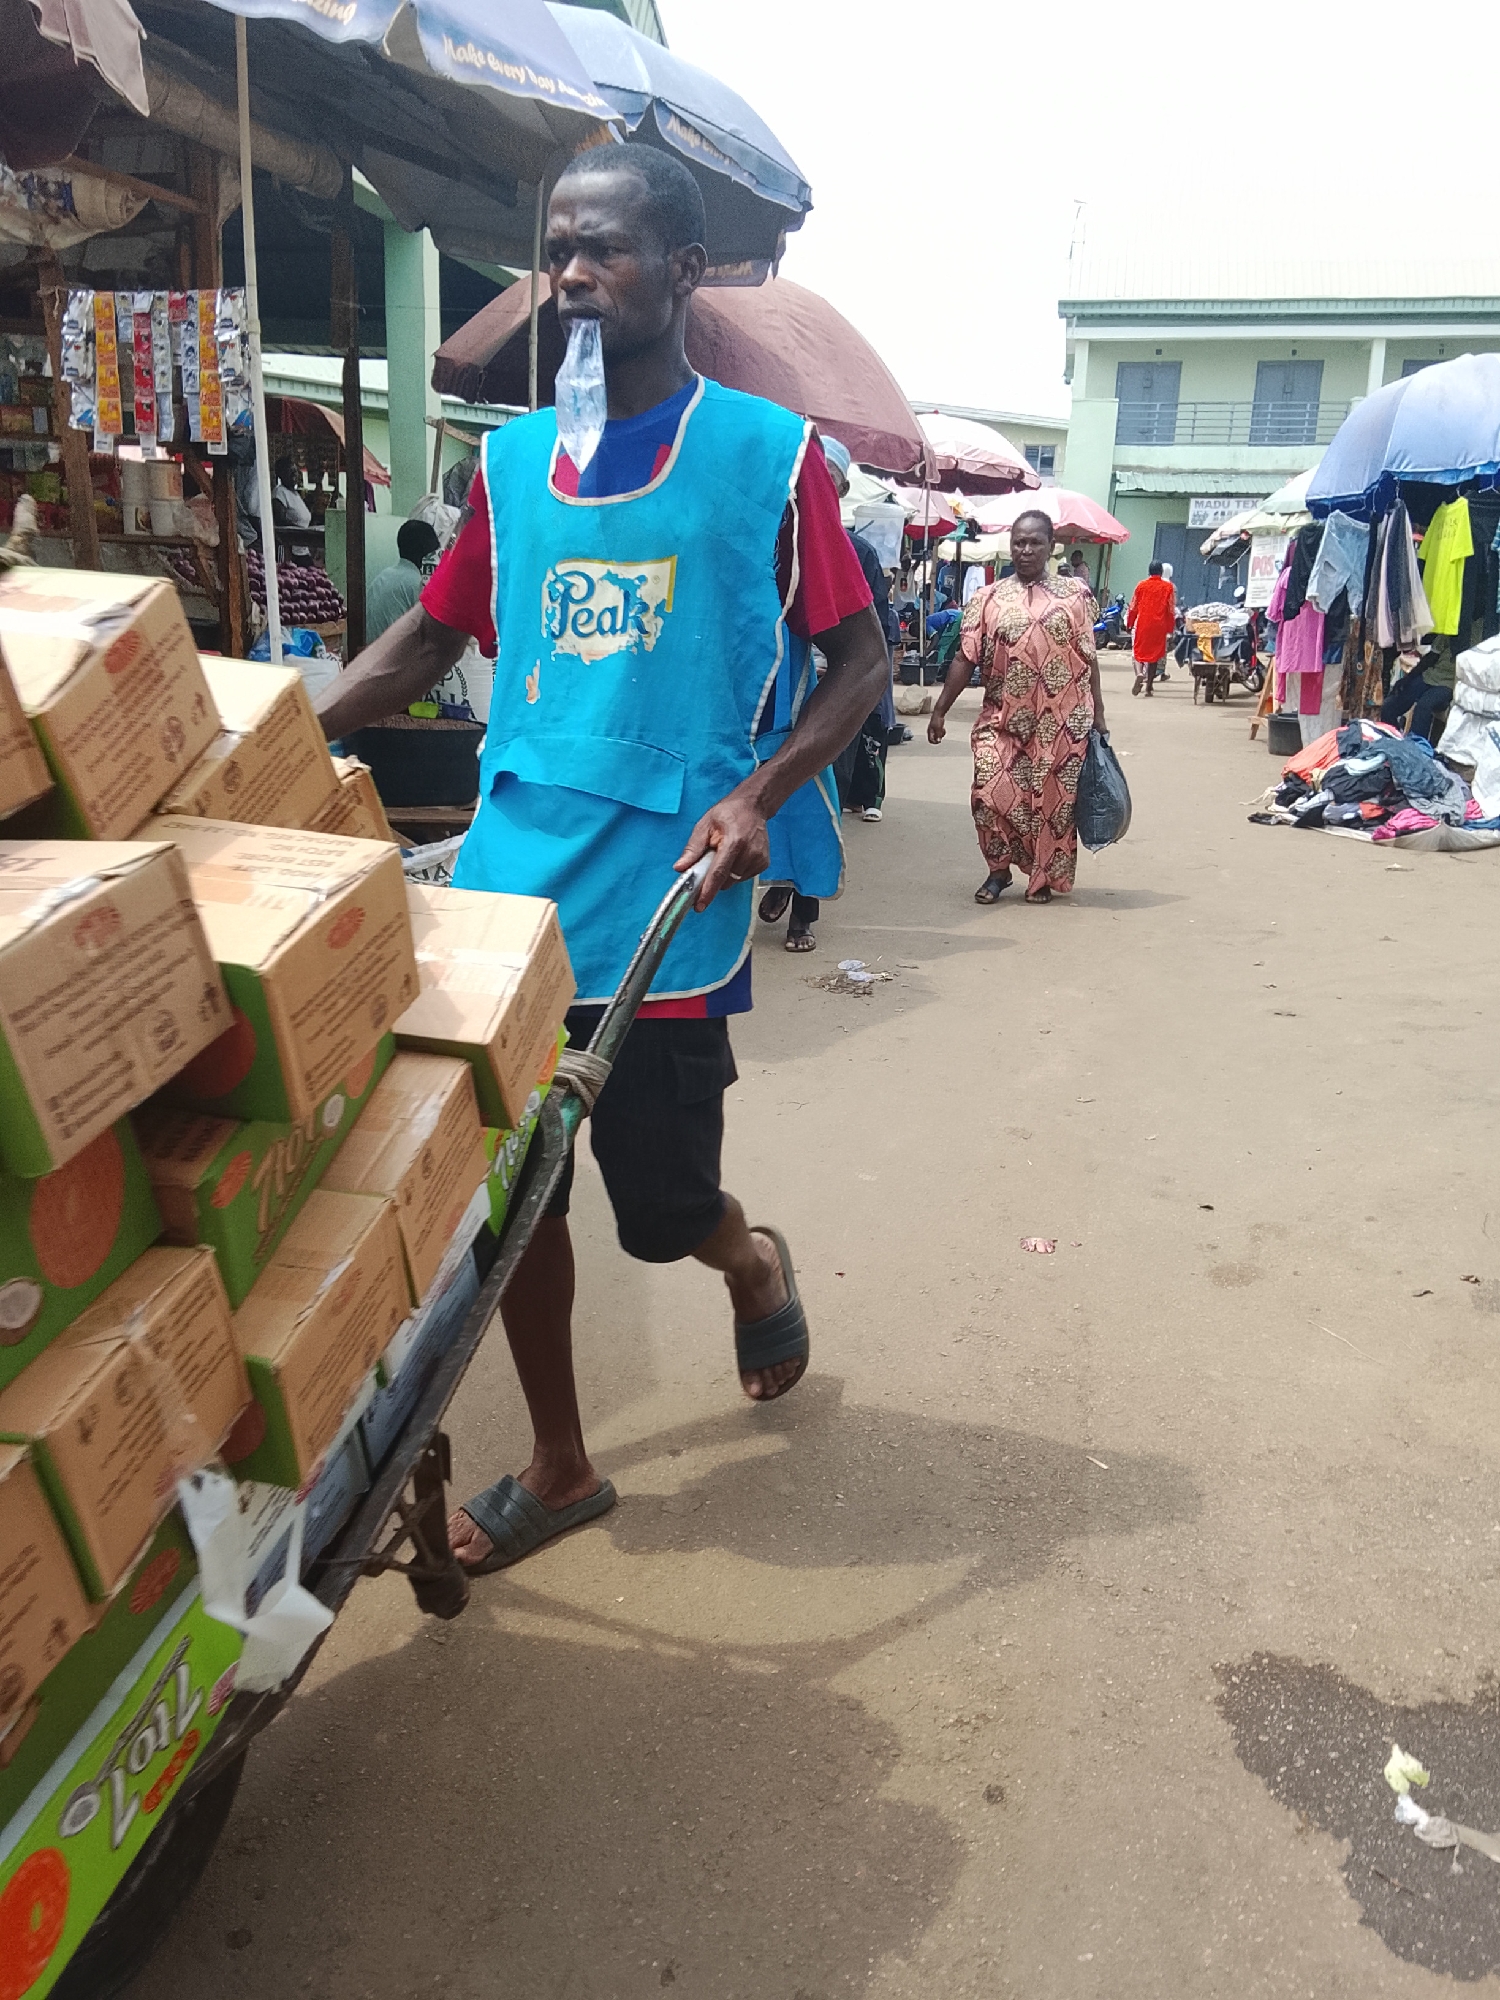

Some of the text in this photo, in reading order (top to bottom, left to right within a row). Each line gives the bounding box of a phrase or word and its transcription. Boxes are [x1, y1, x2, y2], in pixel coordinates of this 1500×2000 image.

[1194, 500, 1231, 509] MADU
[1251, 555, 1275, 577] POS
[547, 570, 649, 641] Peak
